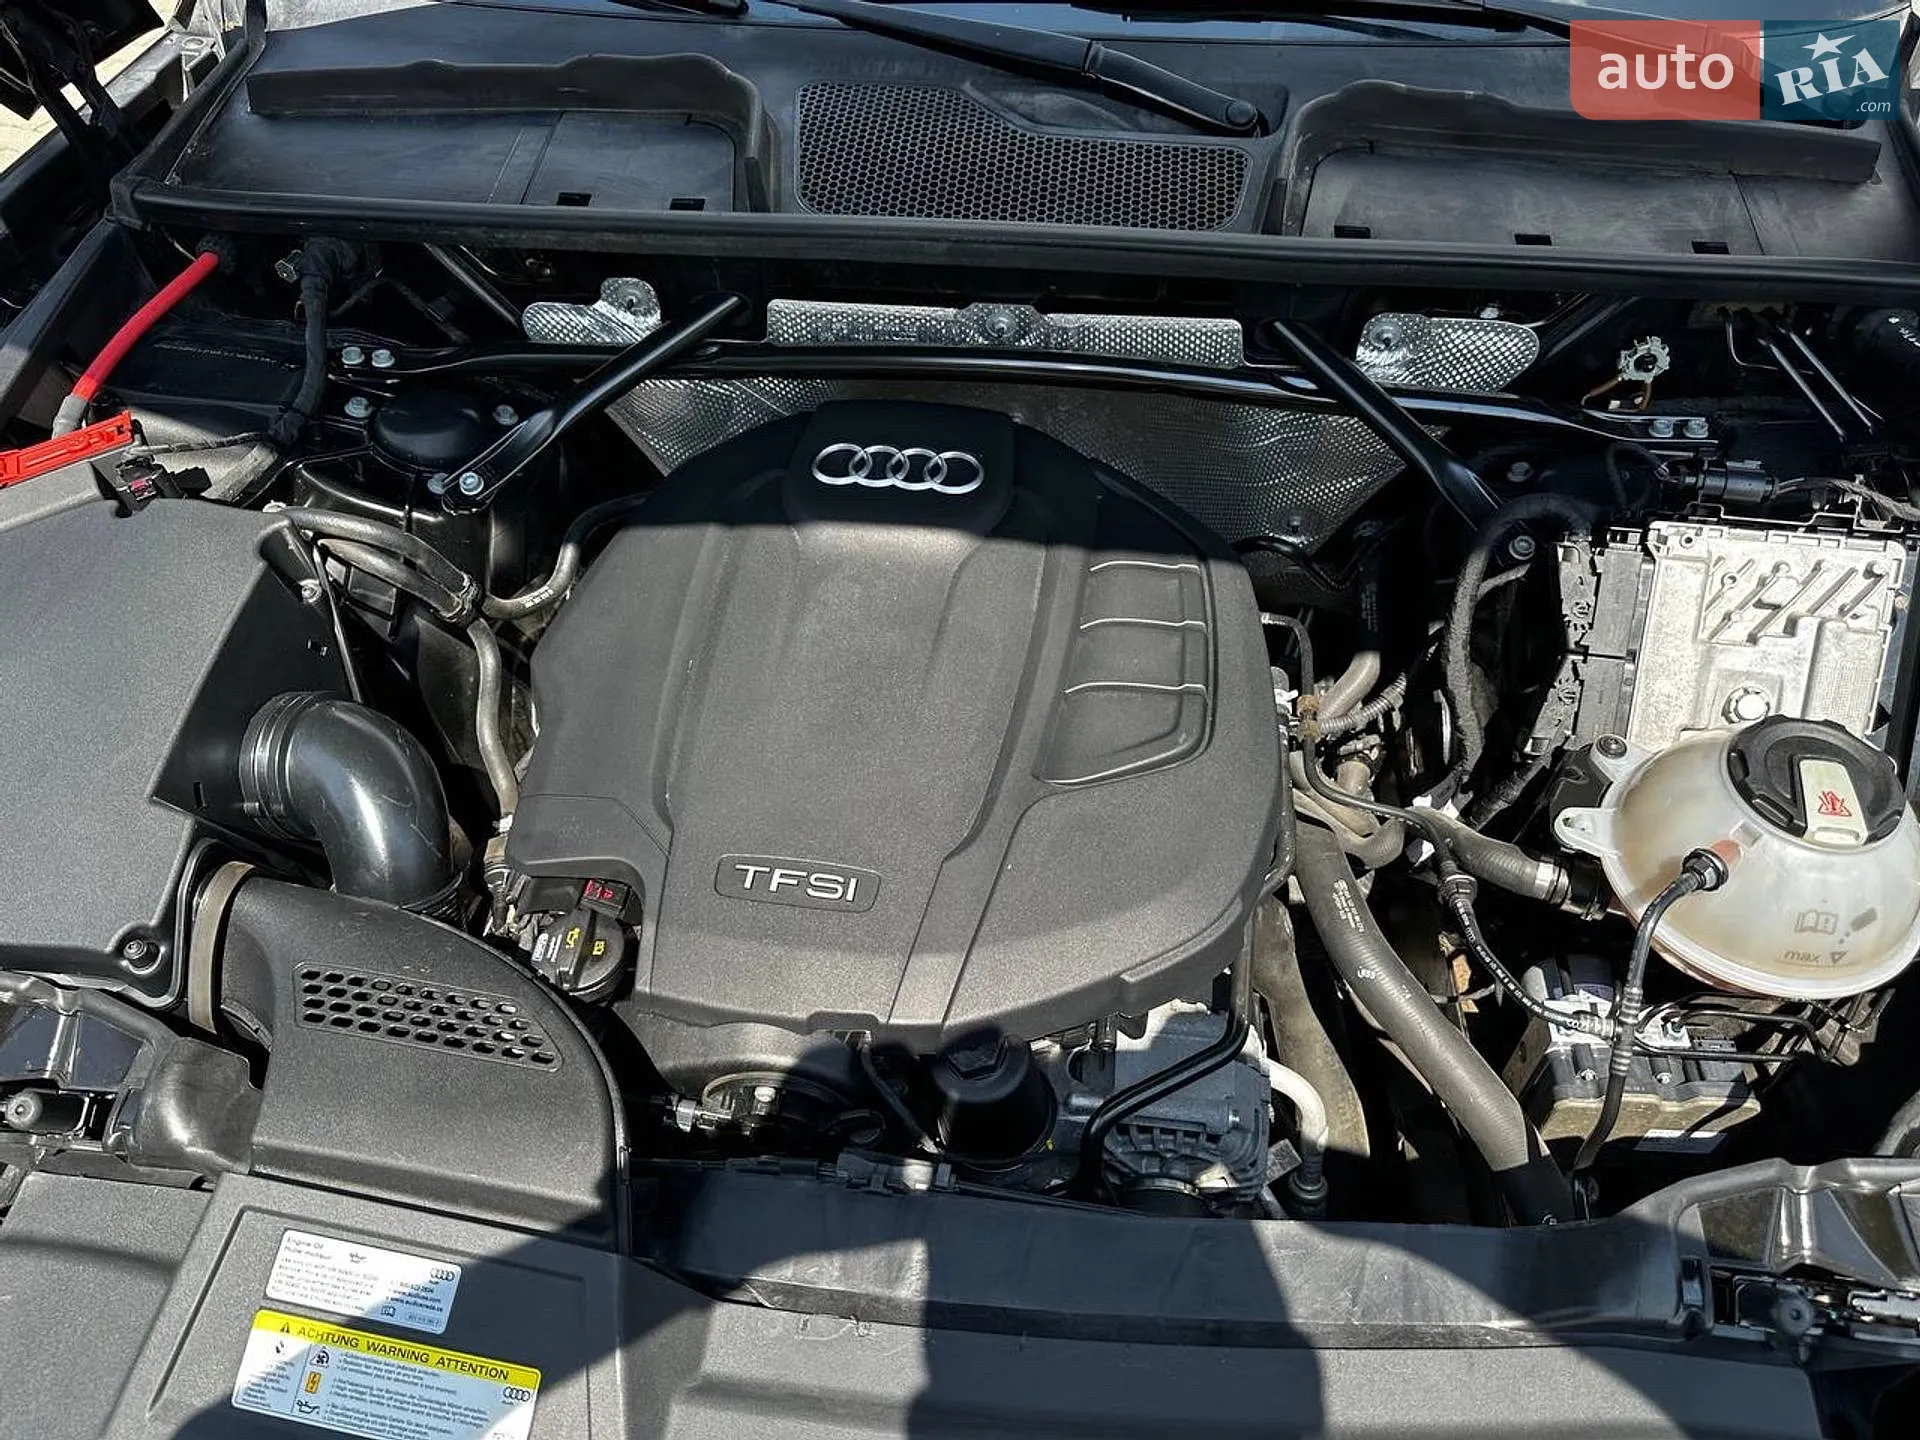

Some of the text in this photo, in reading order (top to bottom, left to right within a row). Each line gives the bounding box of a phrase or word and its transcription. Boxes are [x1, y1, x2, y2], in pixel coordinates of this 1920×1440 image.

[735, 864, 859, 902] TFSI
[298, 1324, 360, 1348] ACHTUNG
[366, 1340, 430, 1364] WARNING
[435, 1356, 510, 1381] ATTENTION
